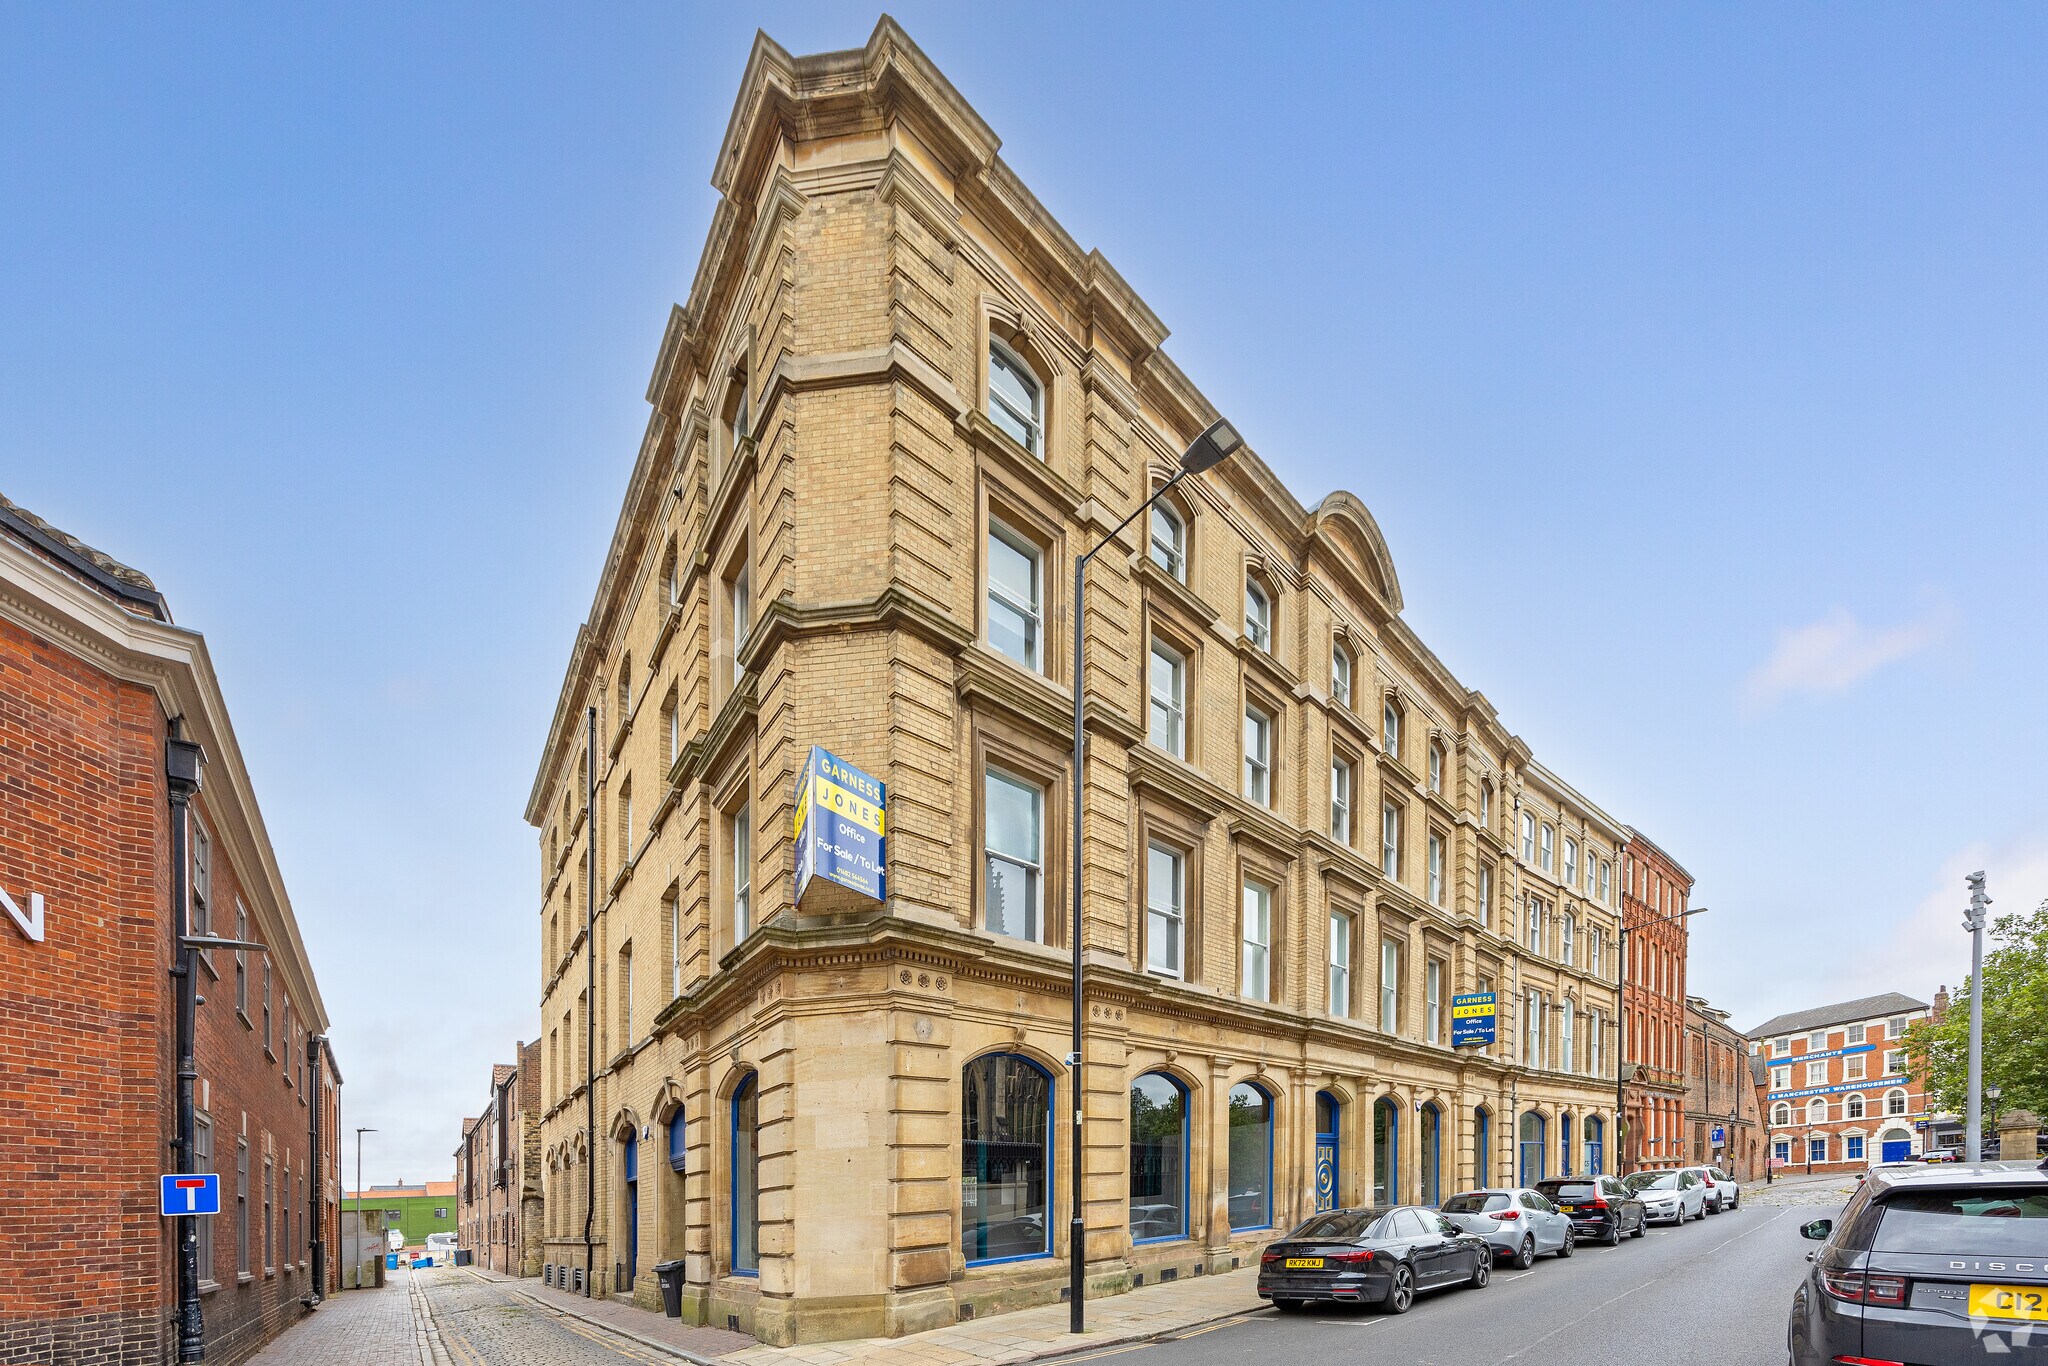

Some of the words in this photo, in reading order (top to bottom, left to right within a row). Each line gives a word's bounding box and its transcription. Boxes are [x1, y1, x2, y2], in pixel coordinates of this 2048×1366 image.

[821, 758, 880, 800] GARNESS
[823, 788, 880, 827] JONES
[839, 823, 866, 844] Office
[817, 836, 833, 853] For
[834, 844, 853, 862] Sale
[860, 855, 871, 869] To
[871, 861, 885, 876] Let
[1456, 996, 1492, 1004] GARNESS
[1457, 1007, 1492, 1015] JONES
[1791, 1050, 1842, 1062] MERCHANTS
[1777, 1087, 1830, 1098] MANCHESTER
[1833, 1079, 1903, 1091] WAREHOUSEMEN
[1949, 1261, 2048, 1273] DISC
[1996, 1292, 2048, 1311] C12
